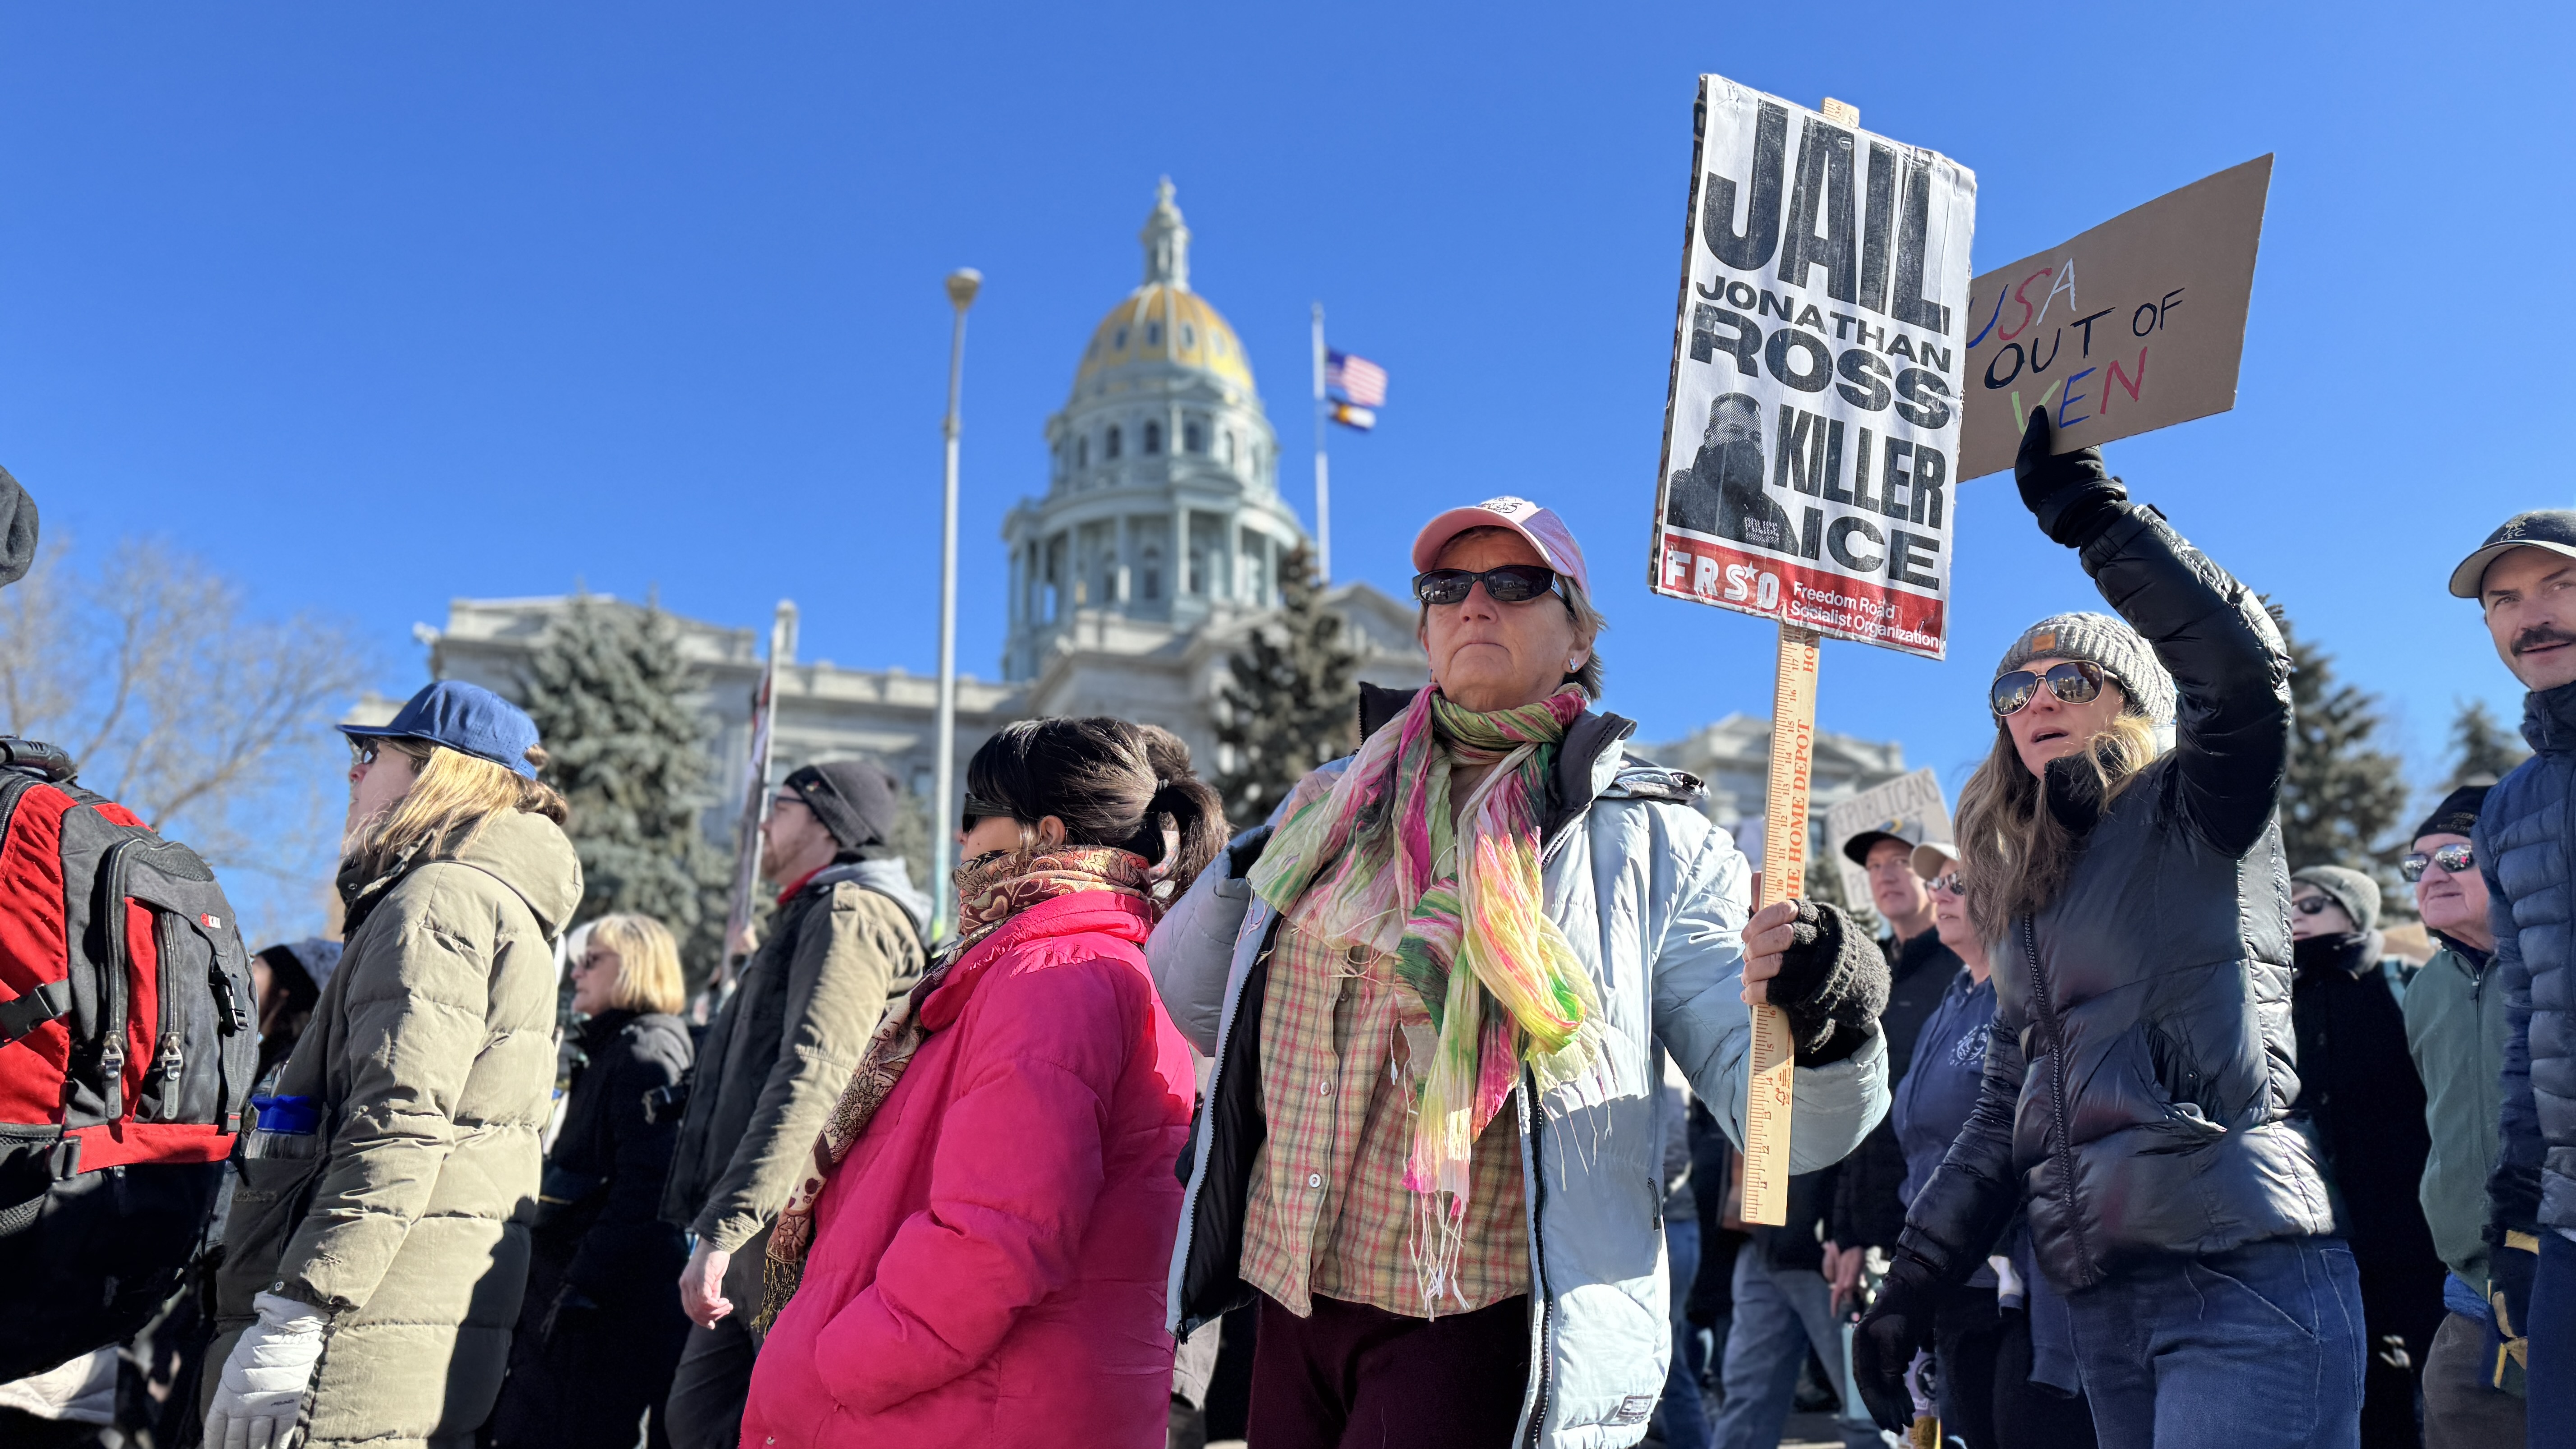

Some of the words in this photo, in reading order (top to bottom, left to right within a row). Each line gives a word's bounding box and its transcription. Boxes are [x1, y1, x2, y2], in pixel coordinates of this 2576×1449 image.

[1702, 98, 1950, 336] JAIL
[1696, 275, 1952, 373] JONATHAN
[1966, 258, 2076, 349] USA
[1984, 307, 2116, 389] OUT
[2132, 287, 2185, 337] OF
[1690, 301, 1950, 430] ROSS
[2011, 346, 2148, 436] VEN
[1773, 403, 1946, 530] KILLER
[1800, 506, 1941, 591] ICE
[1664, 549, 1780, 610] FRSO
[1793, 581, 1857, 609] Freedom
[1859, 598, 1895, 620] Road
[1790, 601, 1852, 628] Socialist
[1854, 616, 1939, 649] Organization
[1792, 658, 1799, 671] 17
[1789, 688, 1797, 702] 16
[1787, 720, 1794, 733] 15
[1785, 752, 1792, 764] 14
[1793, 718, 1810, 793] DEPOT
[1782, 783, 1790, 796] 13
[1780, 815, 1788, 827] 12
[1789, 796, 1805, 863] HOME
[1778, 847, 1786, 859] 11
[1776, 879, 1784, 892] 10
[1786, 868, 1801, 899] HE
